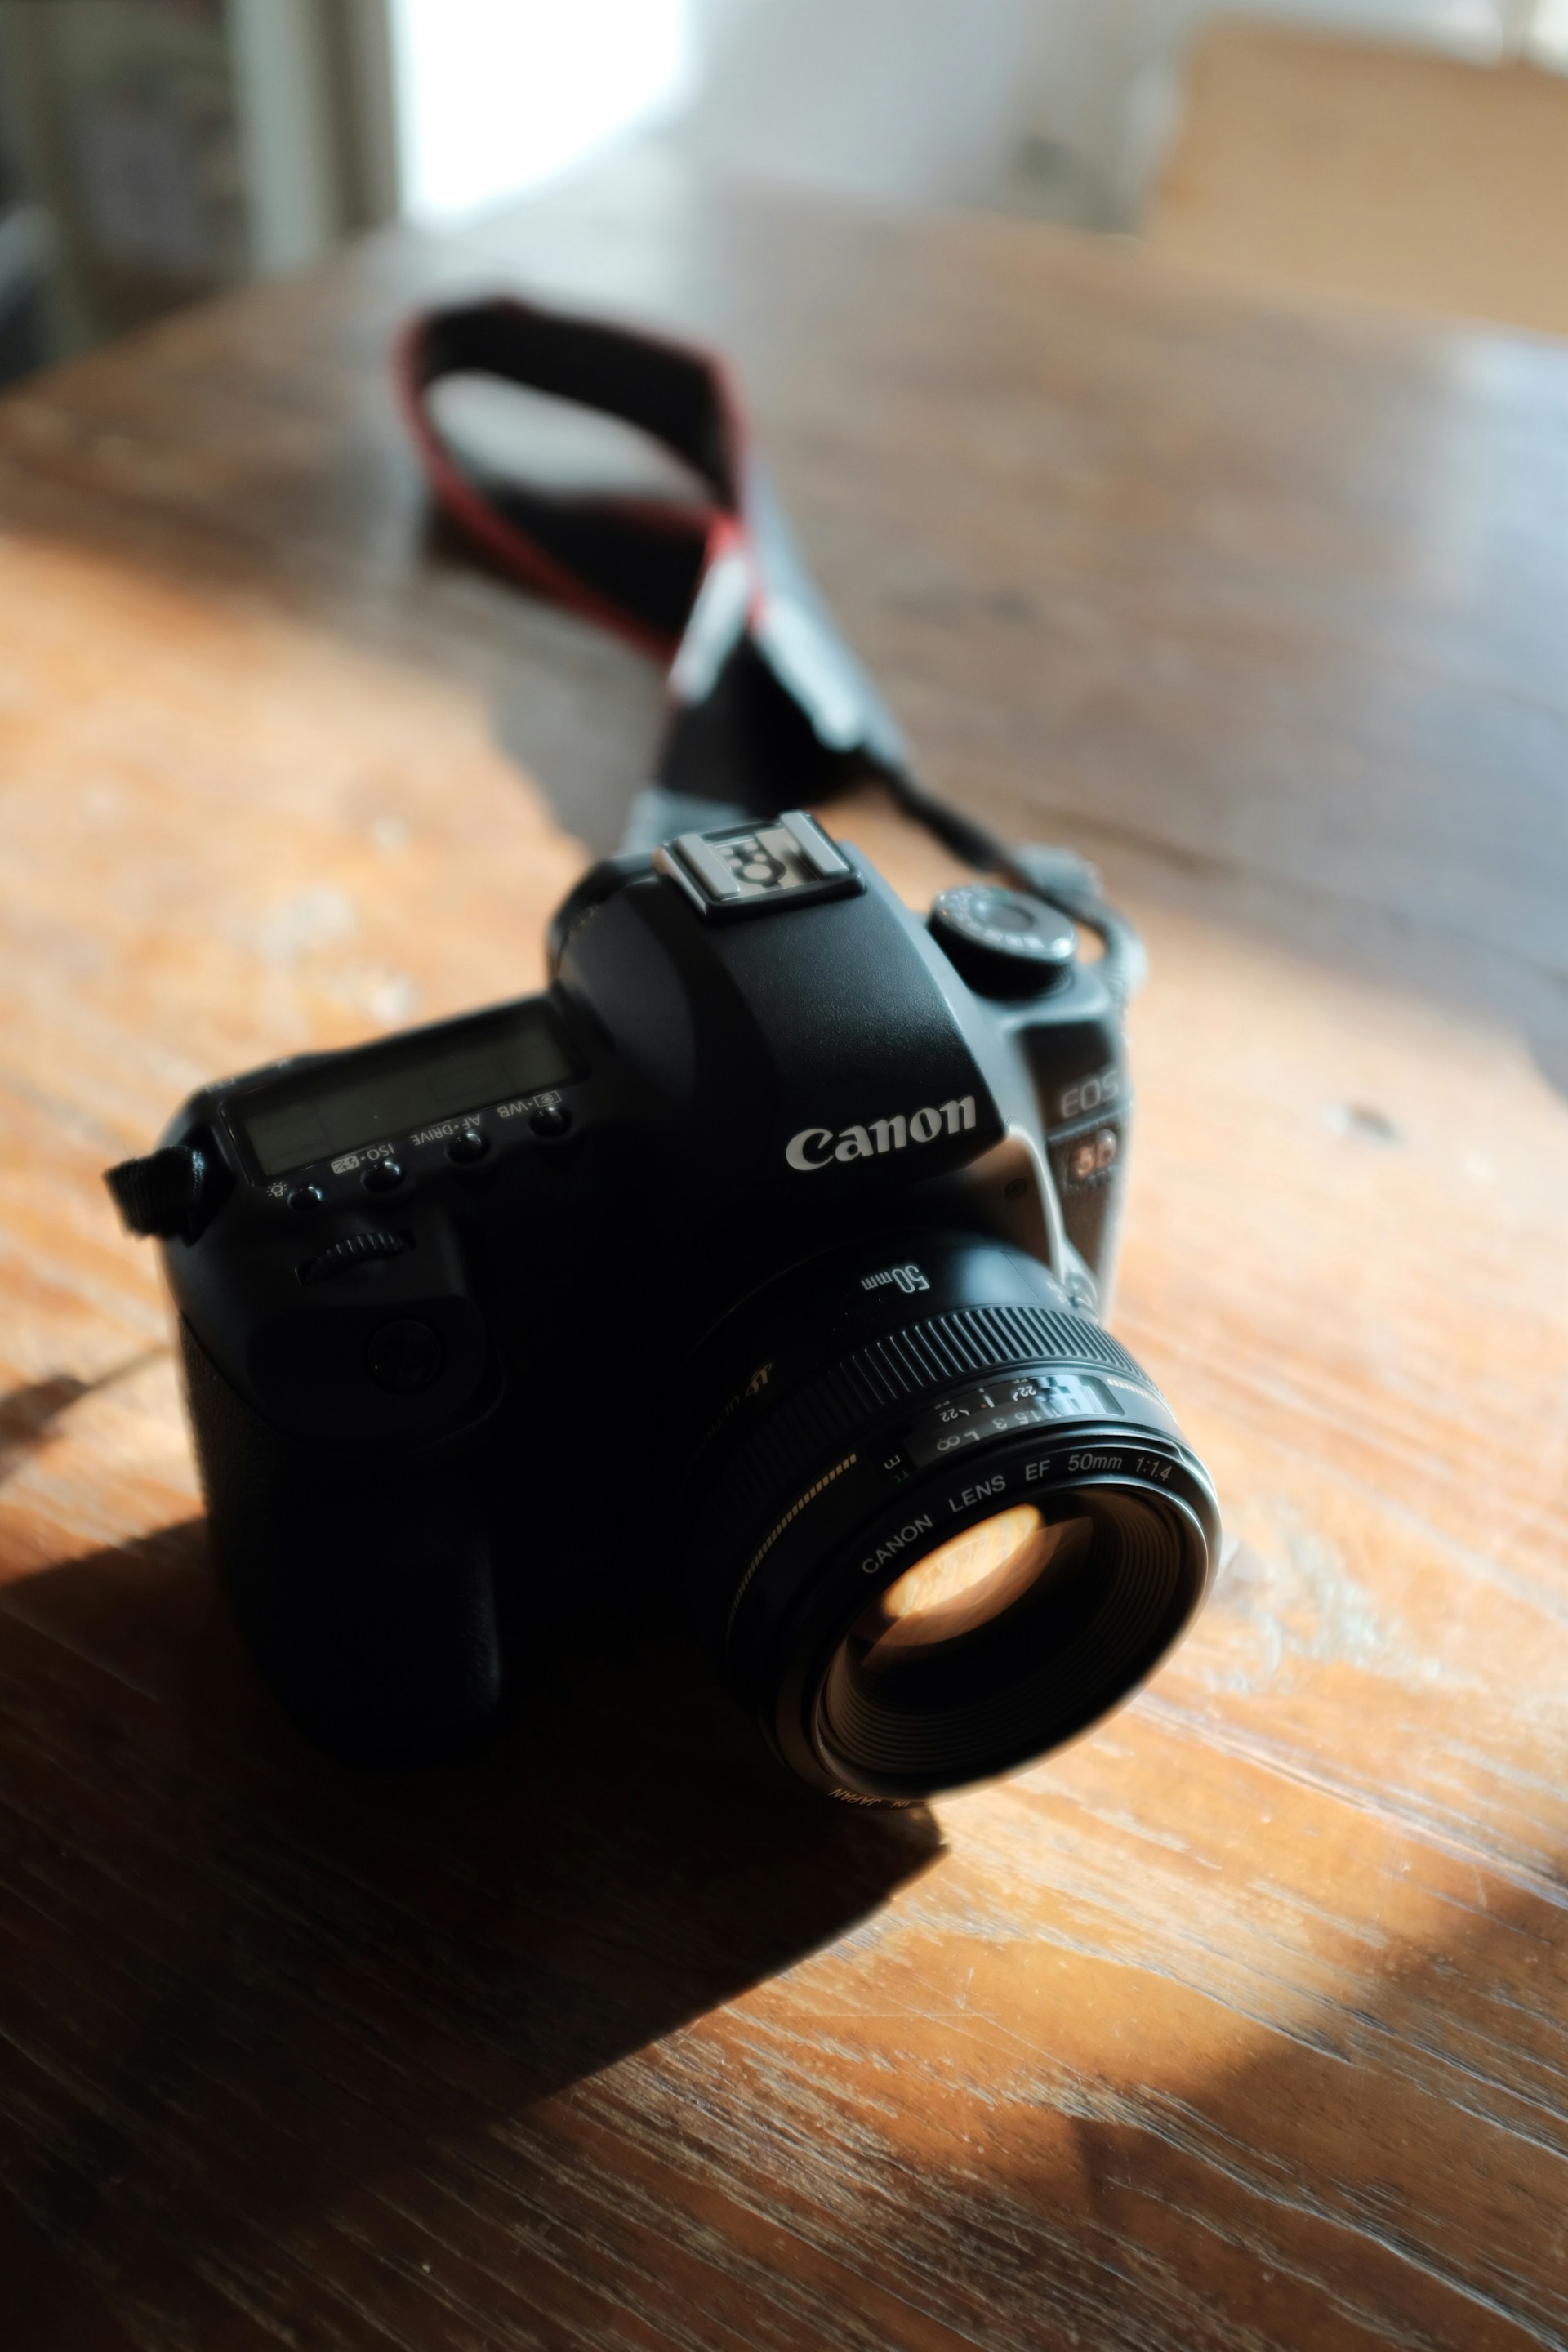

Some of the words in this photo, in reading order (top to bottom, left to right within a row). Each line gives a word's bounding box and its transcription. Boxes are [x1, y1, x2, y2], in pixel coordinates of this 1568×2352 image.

[1061, 1069, 1120, 1119] EOS
[497, 1101, 529, 1118] WB
[785, 1094, 977, 1171] Canon
[367, 1143, 395, 1160] ISO
[860, 1264, 931, 1294] 50mm
[862, 1513, 933, 1574] CANON
[948, 1474, 1006, 1513] LENS
[1025, 1459, 1051, 1481] EF
[1067, 1453, 1123, 1472] 50mm
[1135, 1456, 1173, 1481] 1:1.4
[827, 1788, 882, 1807] JAPAN
